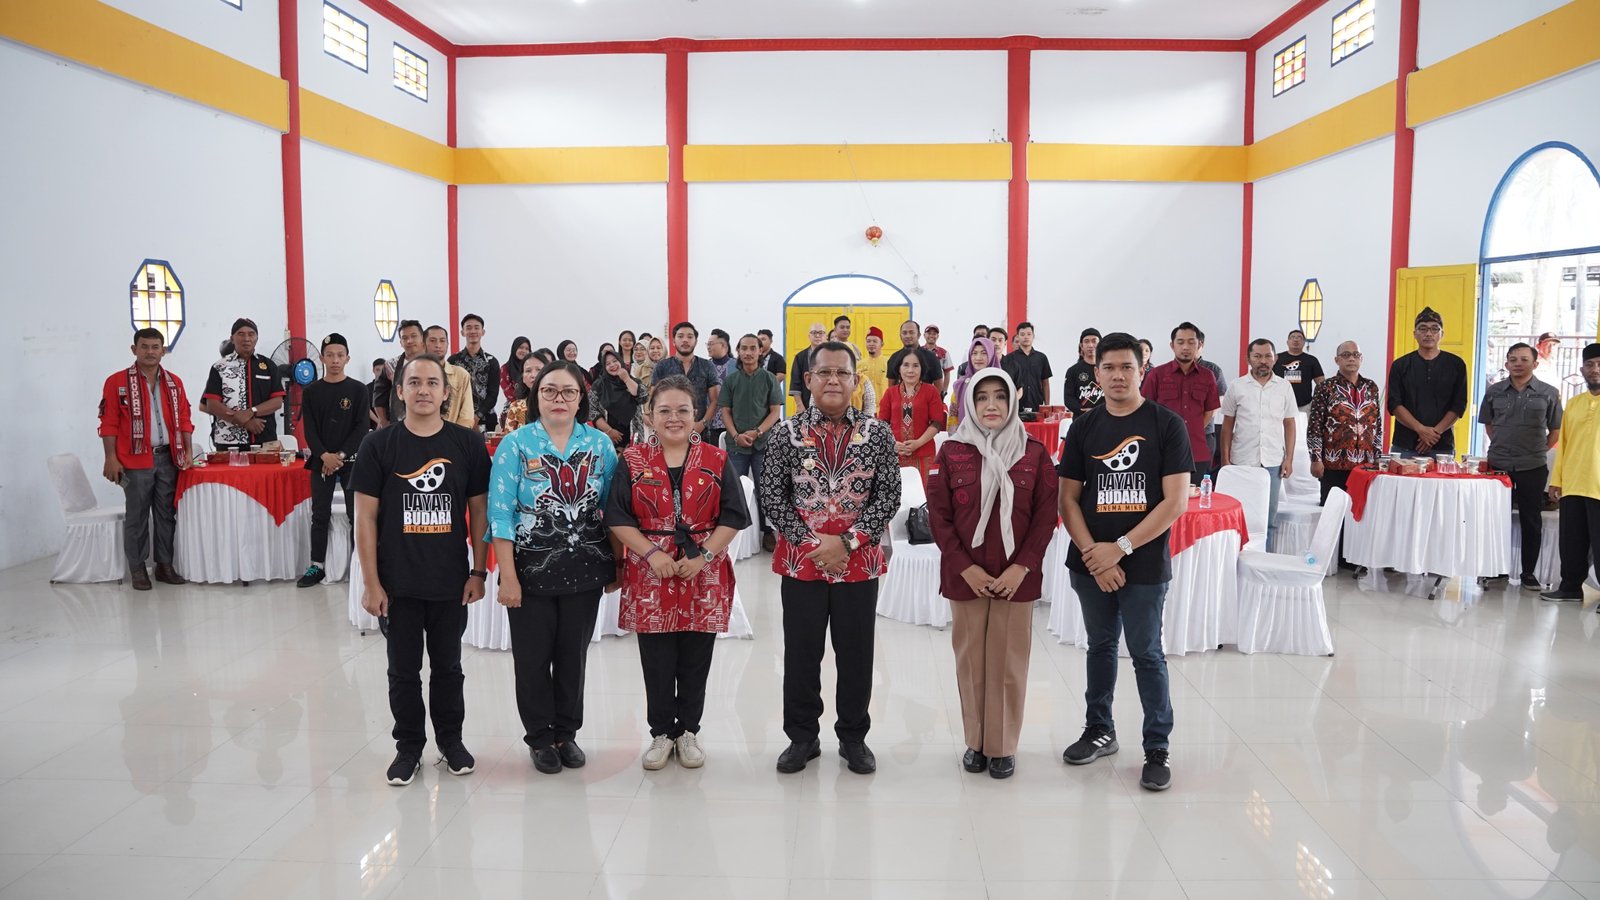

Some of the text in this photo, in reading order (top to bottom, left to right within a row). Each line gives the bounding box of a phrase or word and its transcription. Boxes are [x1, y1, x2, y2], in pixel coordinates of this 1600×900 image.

[130, 376, 141, 416] HORAS
[1097, 471, 1146, 491] LAYAR
[402, 493, 452, 512] LAYAR
[1097, 490, 1147, 505] BUDARA
[403, 511, 452, 525] BUDARA
